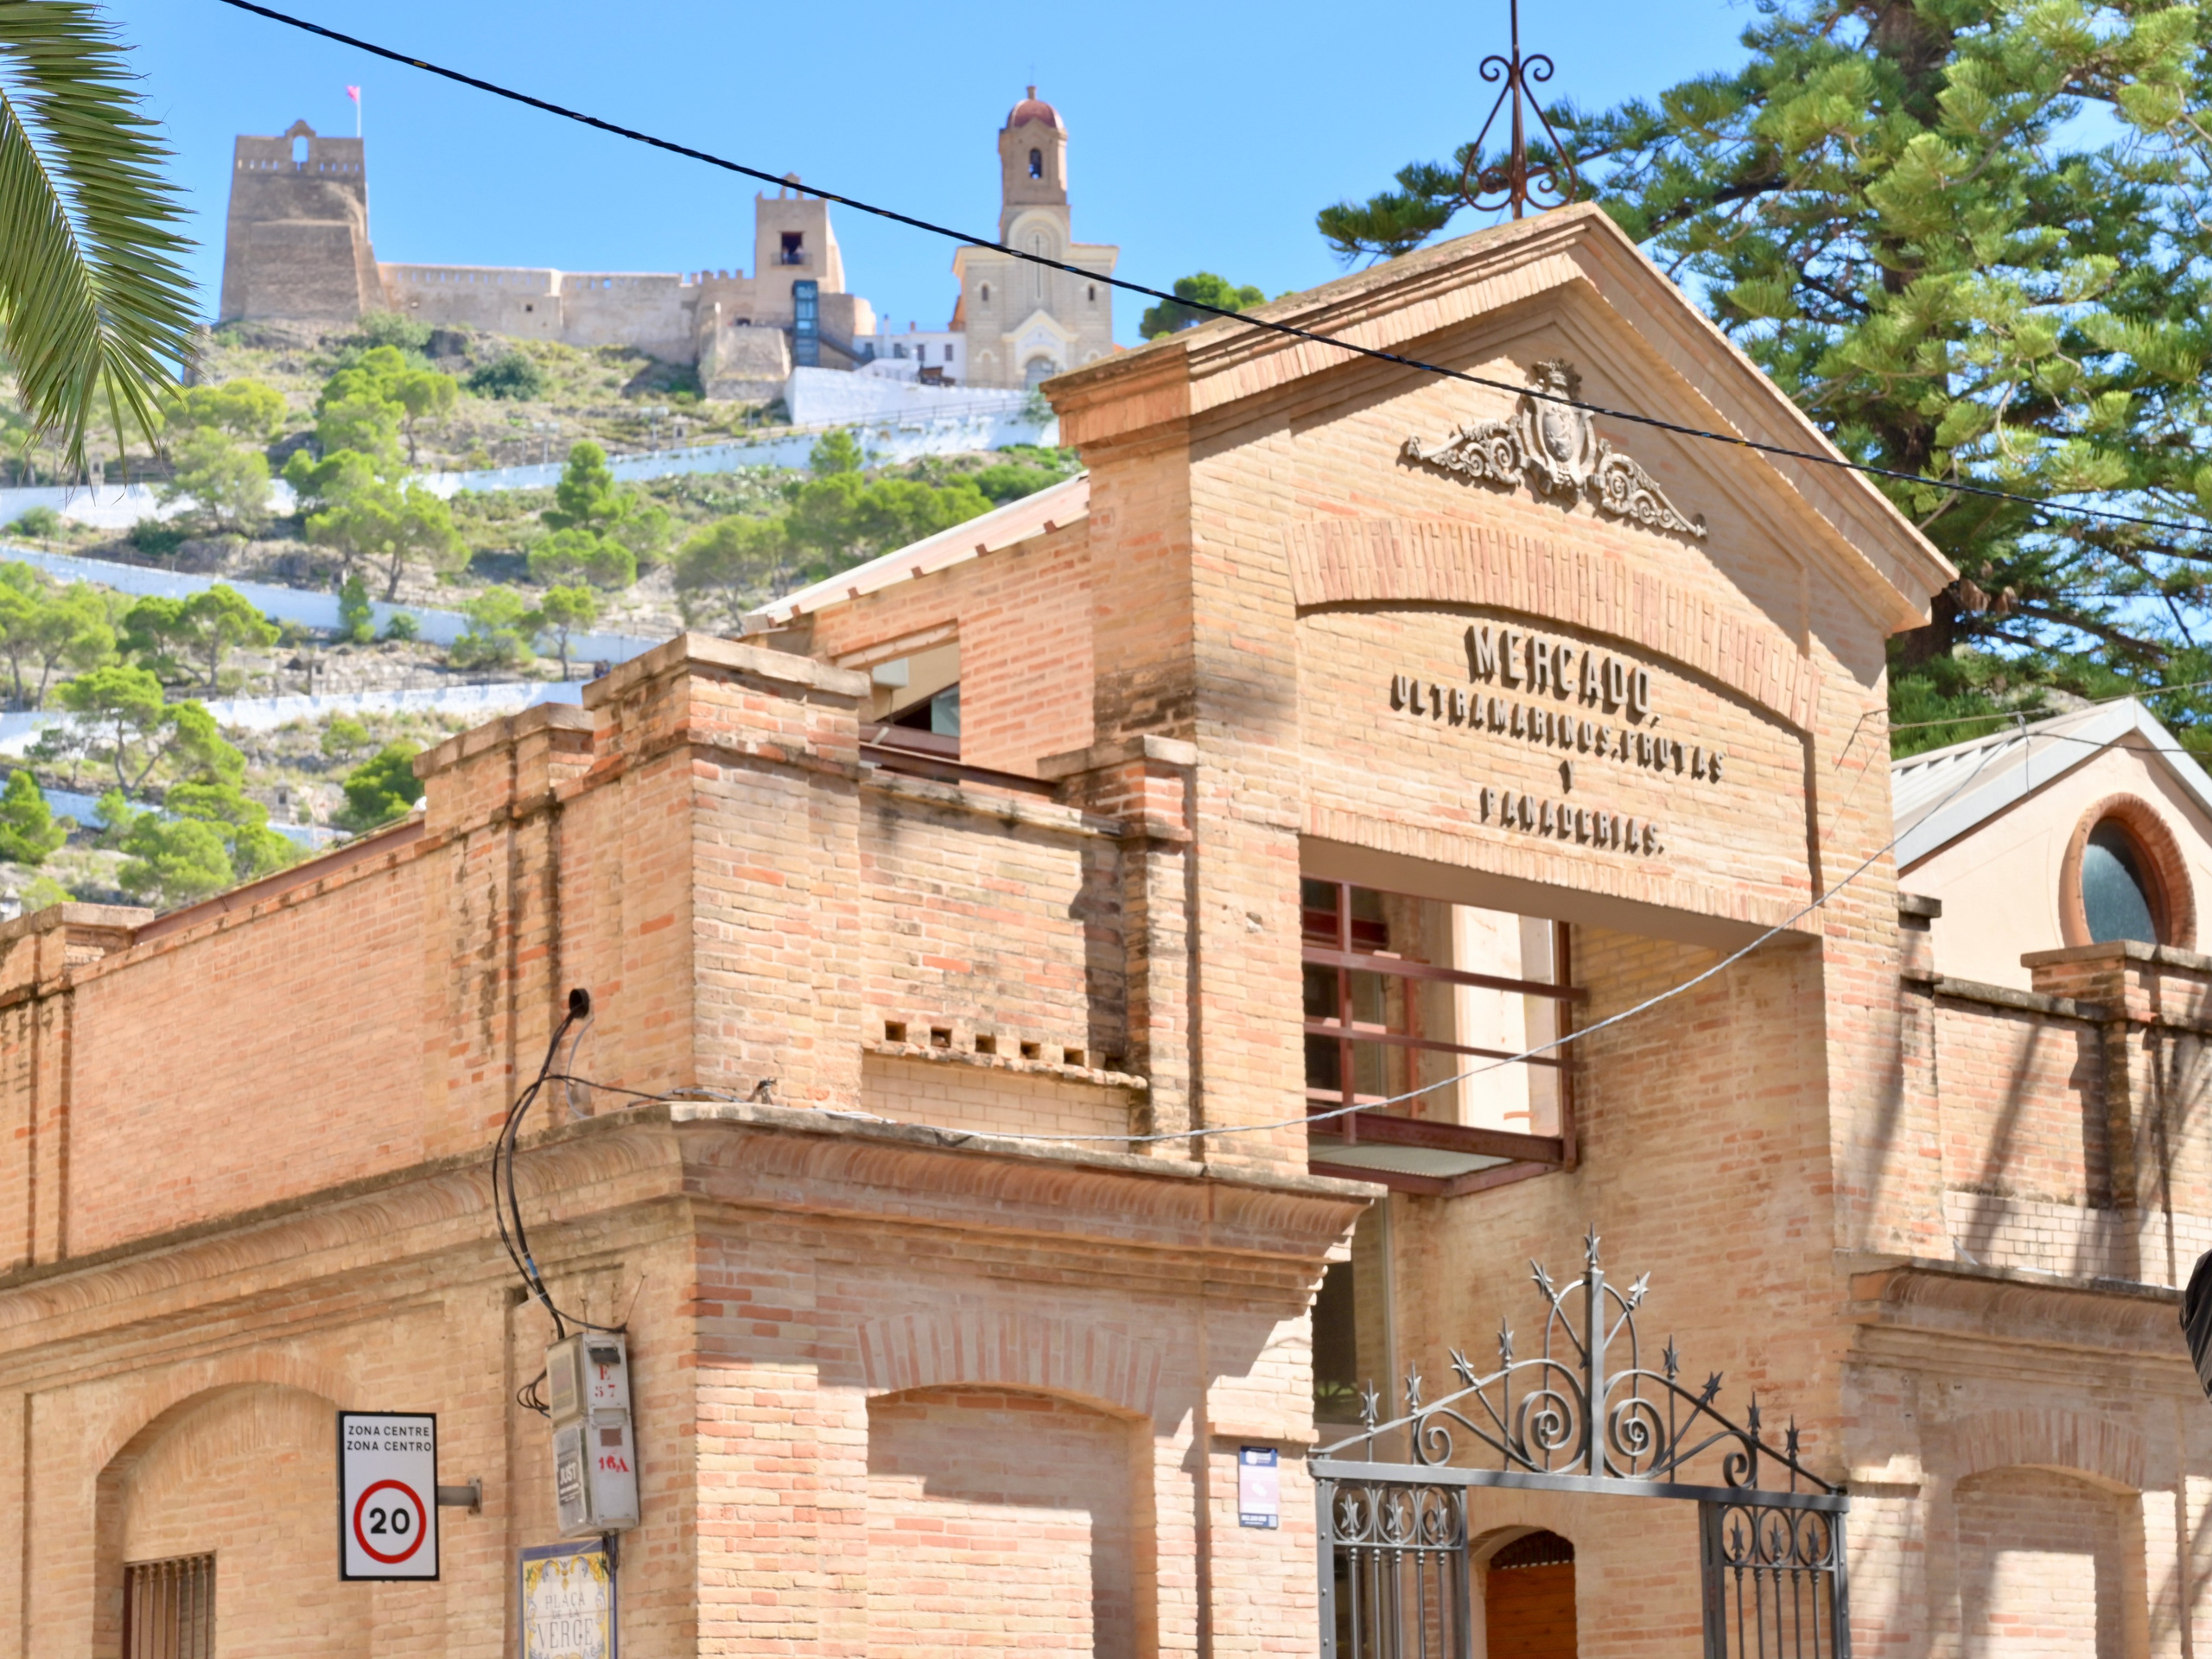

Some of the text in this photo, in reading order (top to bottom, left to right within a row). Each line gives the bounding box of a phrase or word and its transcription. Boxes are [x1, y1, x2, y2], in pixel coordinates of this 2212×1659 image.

[1562, 760, 1576, 790] Y
[347, 1425, 430, 1437] ZONA CENTRE
[346, 1440, 432, 1452] ZONA CENTRO
[369, 1507, 410, 1535] 20
[569, 1608, 580, 1618] LA
[537, 1618, 594, 1649] VERGE
